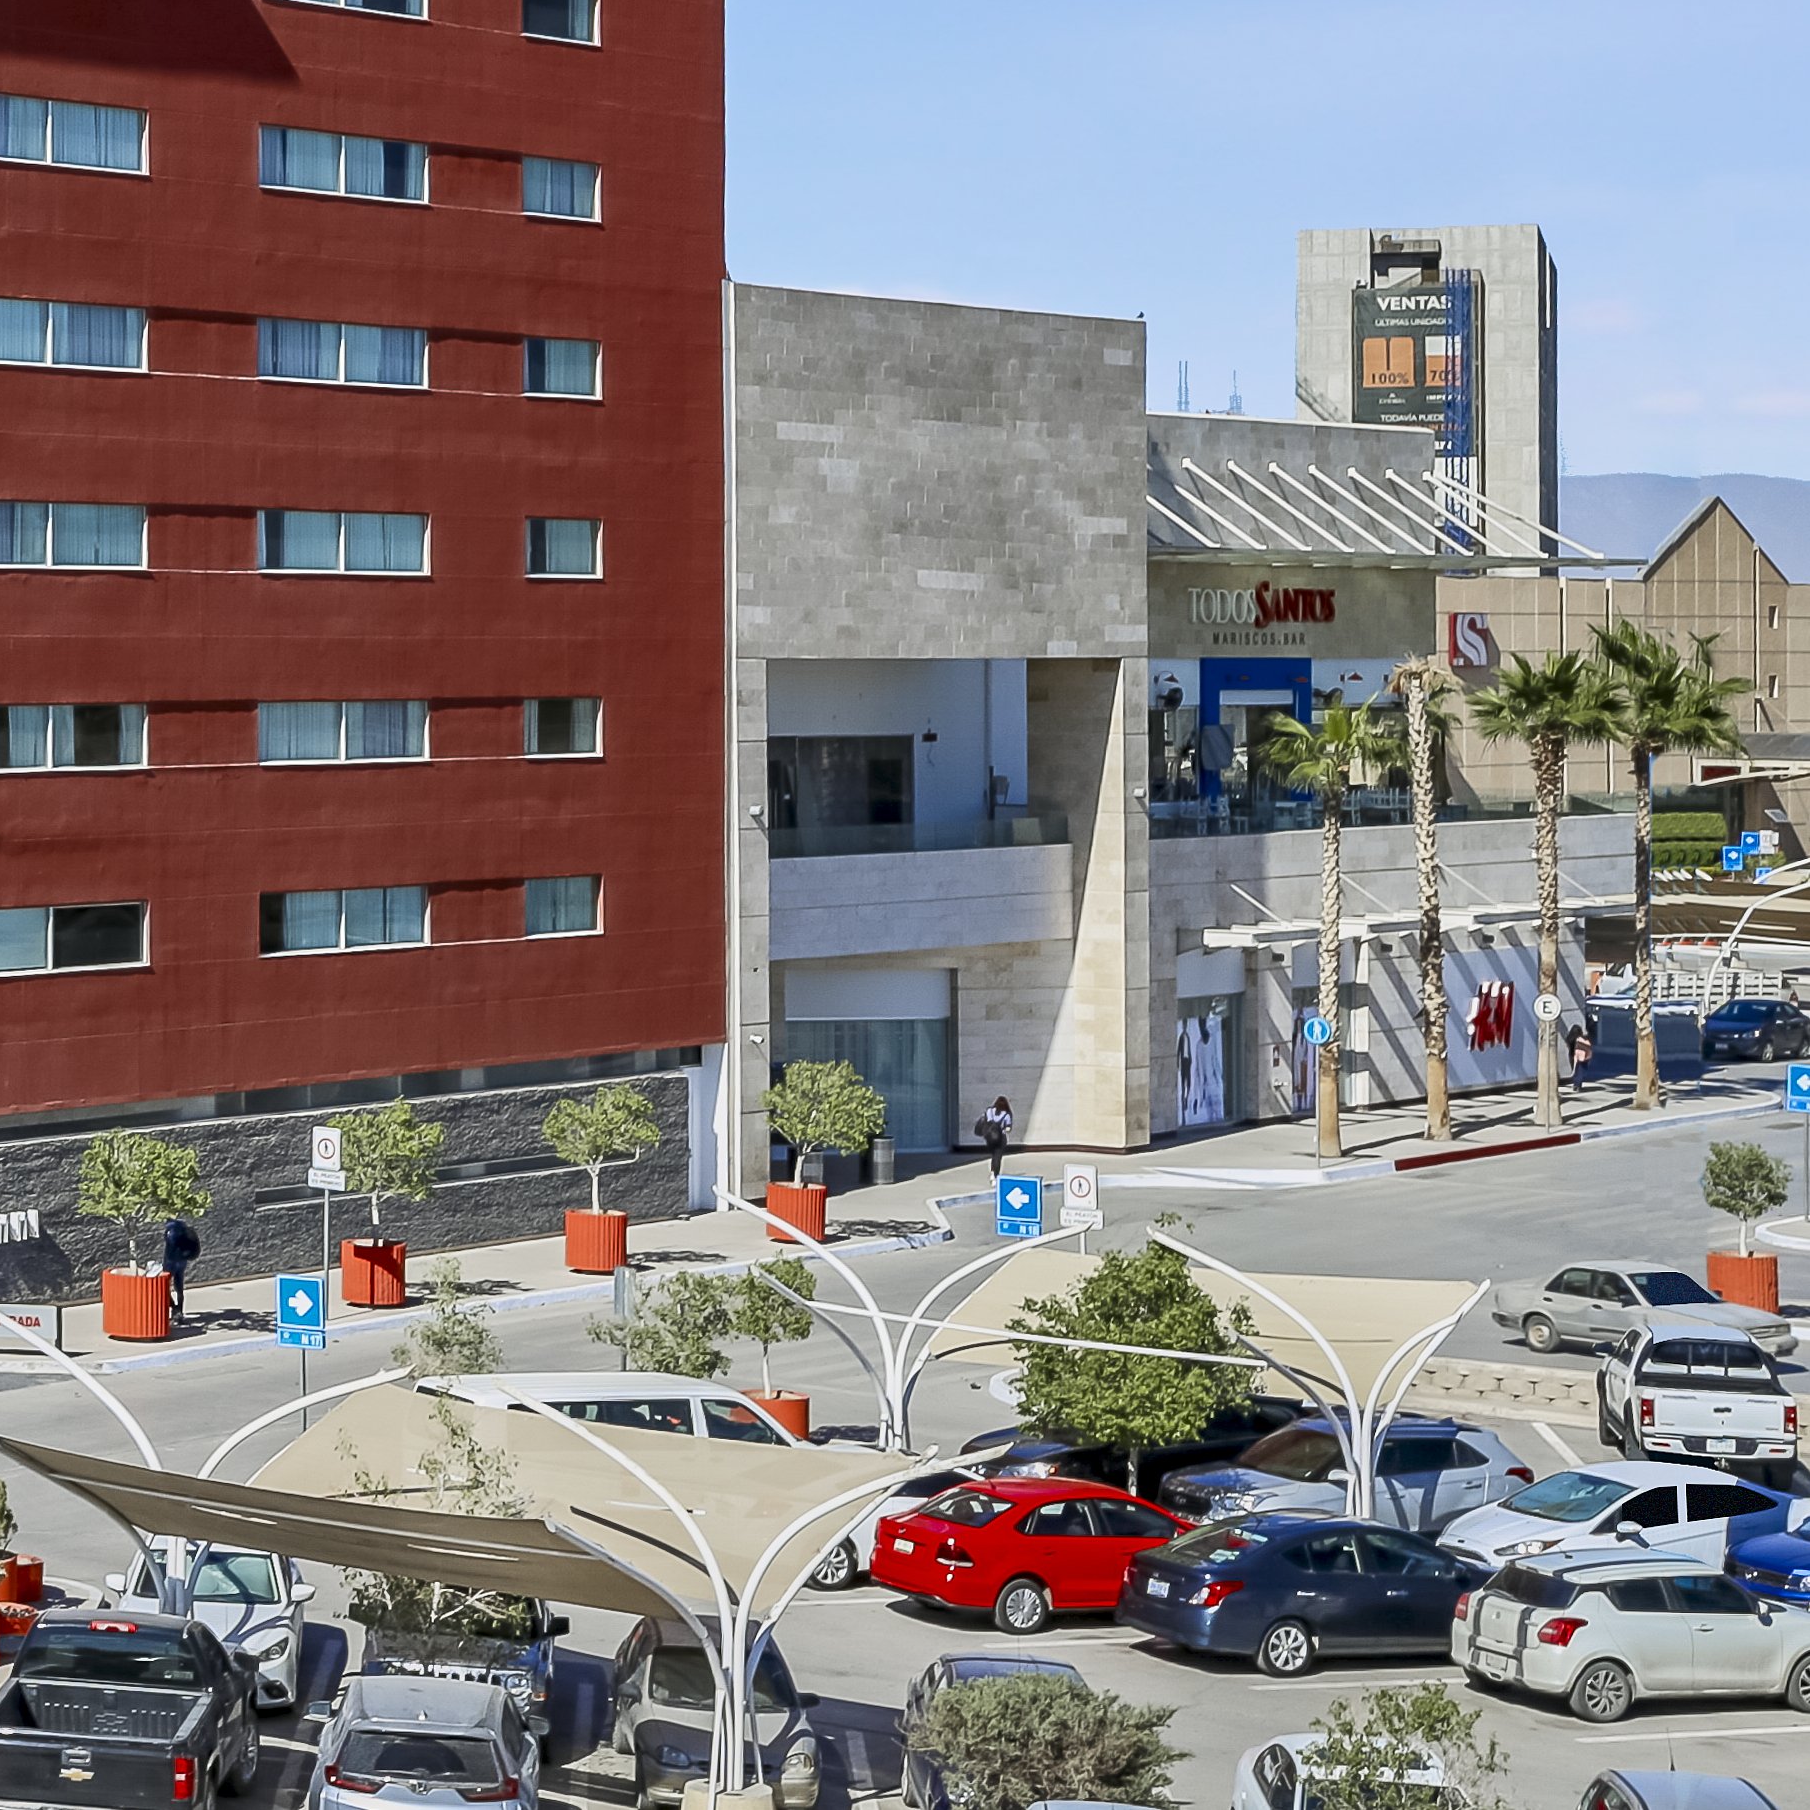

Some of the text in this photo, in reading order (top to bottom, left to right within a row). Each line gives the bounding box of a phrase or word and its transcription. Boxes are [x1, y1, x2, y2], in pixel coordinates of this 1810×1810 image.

[1376, 295, 1452, 311] VENTAS
[1371, 372, 1409, 385] 100%
[1188, 580, 1337, 630] TODOS SANTOS
[1542, 1001, 1553, 1014] E
